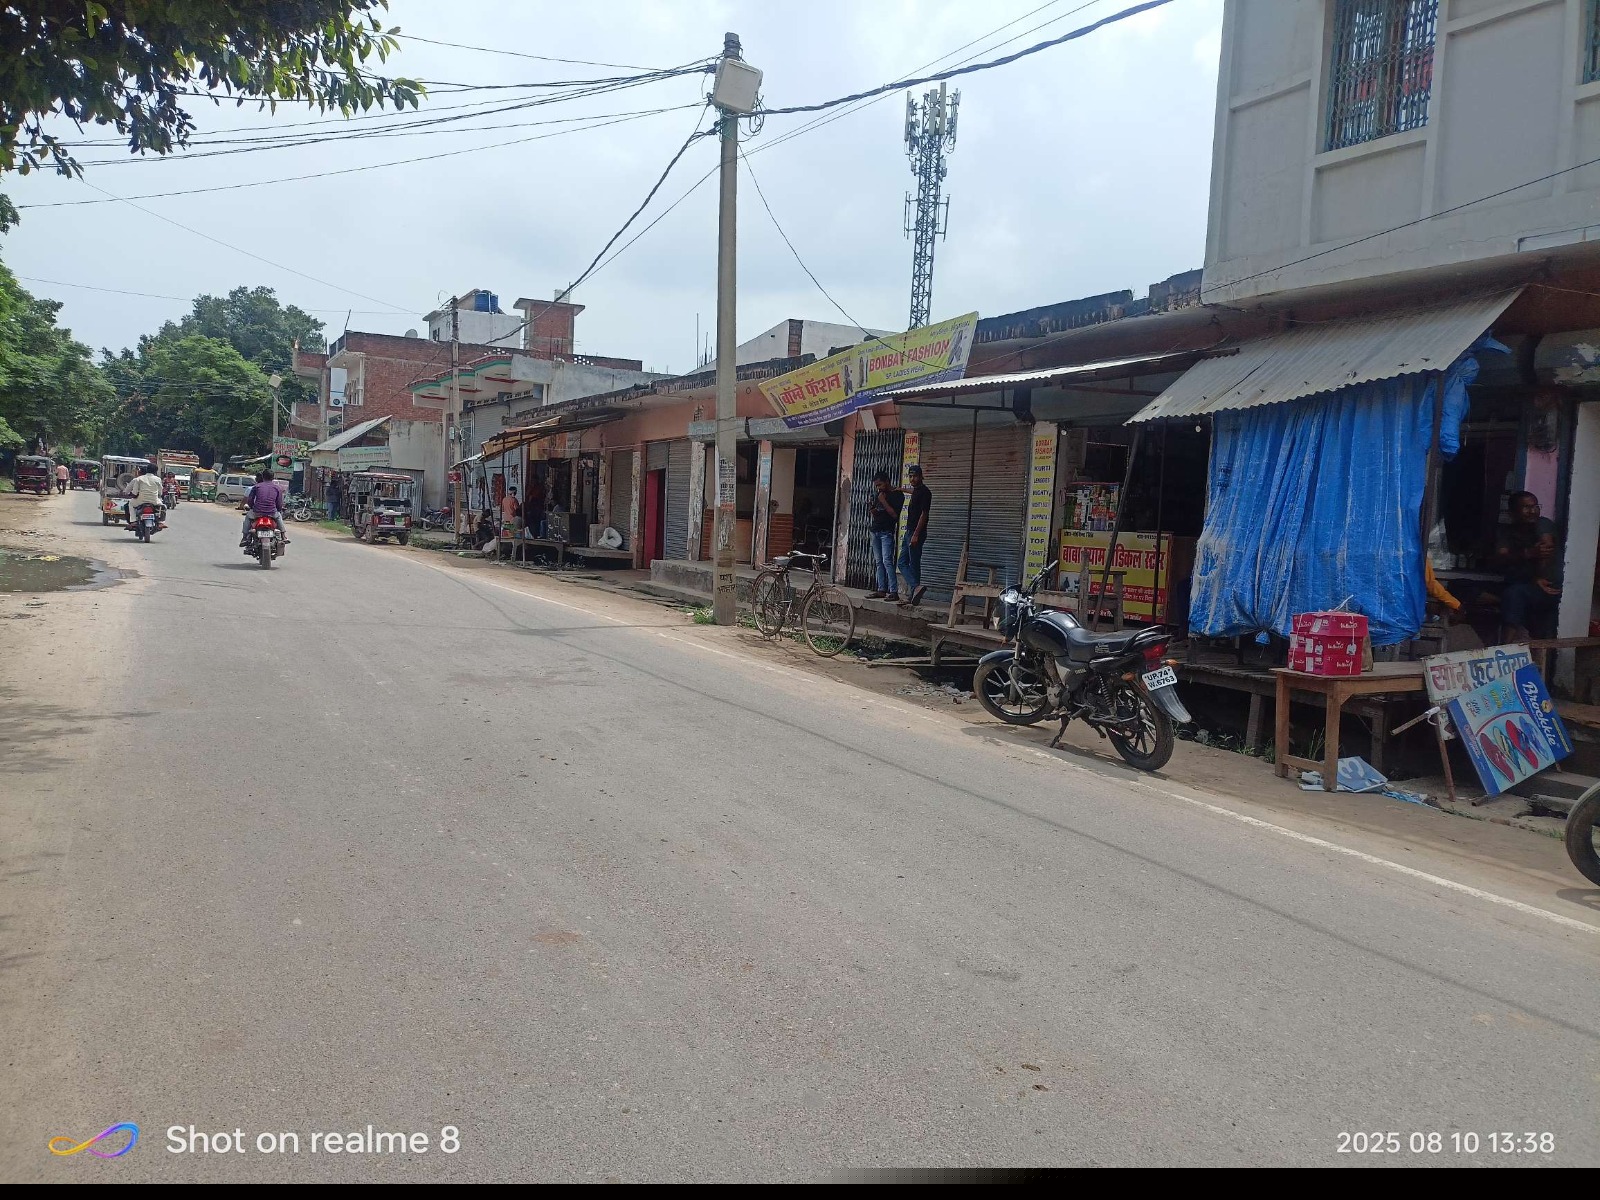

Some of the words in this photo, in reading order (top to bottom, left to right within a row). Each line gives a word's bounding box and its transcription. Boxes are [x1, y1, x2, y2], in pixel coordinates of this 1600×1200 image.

[869, 353, 904, 372] BOMBAY
[907, 339, 951, 363] FASHION
[1062, 545, 1081, 564] बाबा
[1521, 681, 1557, 747] Brockkie
